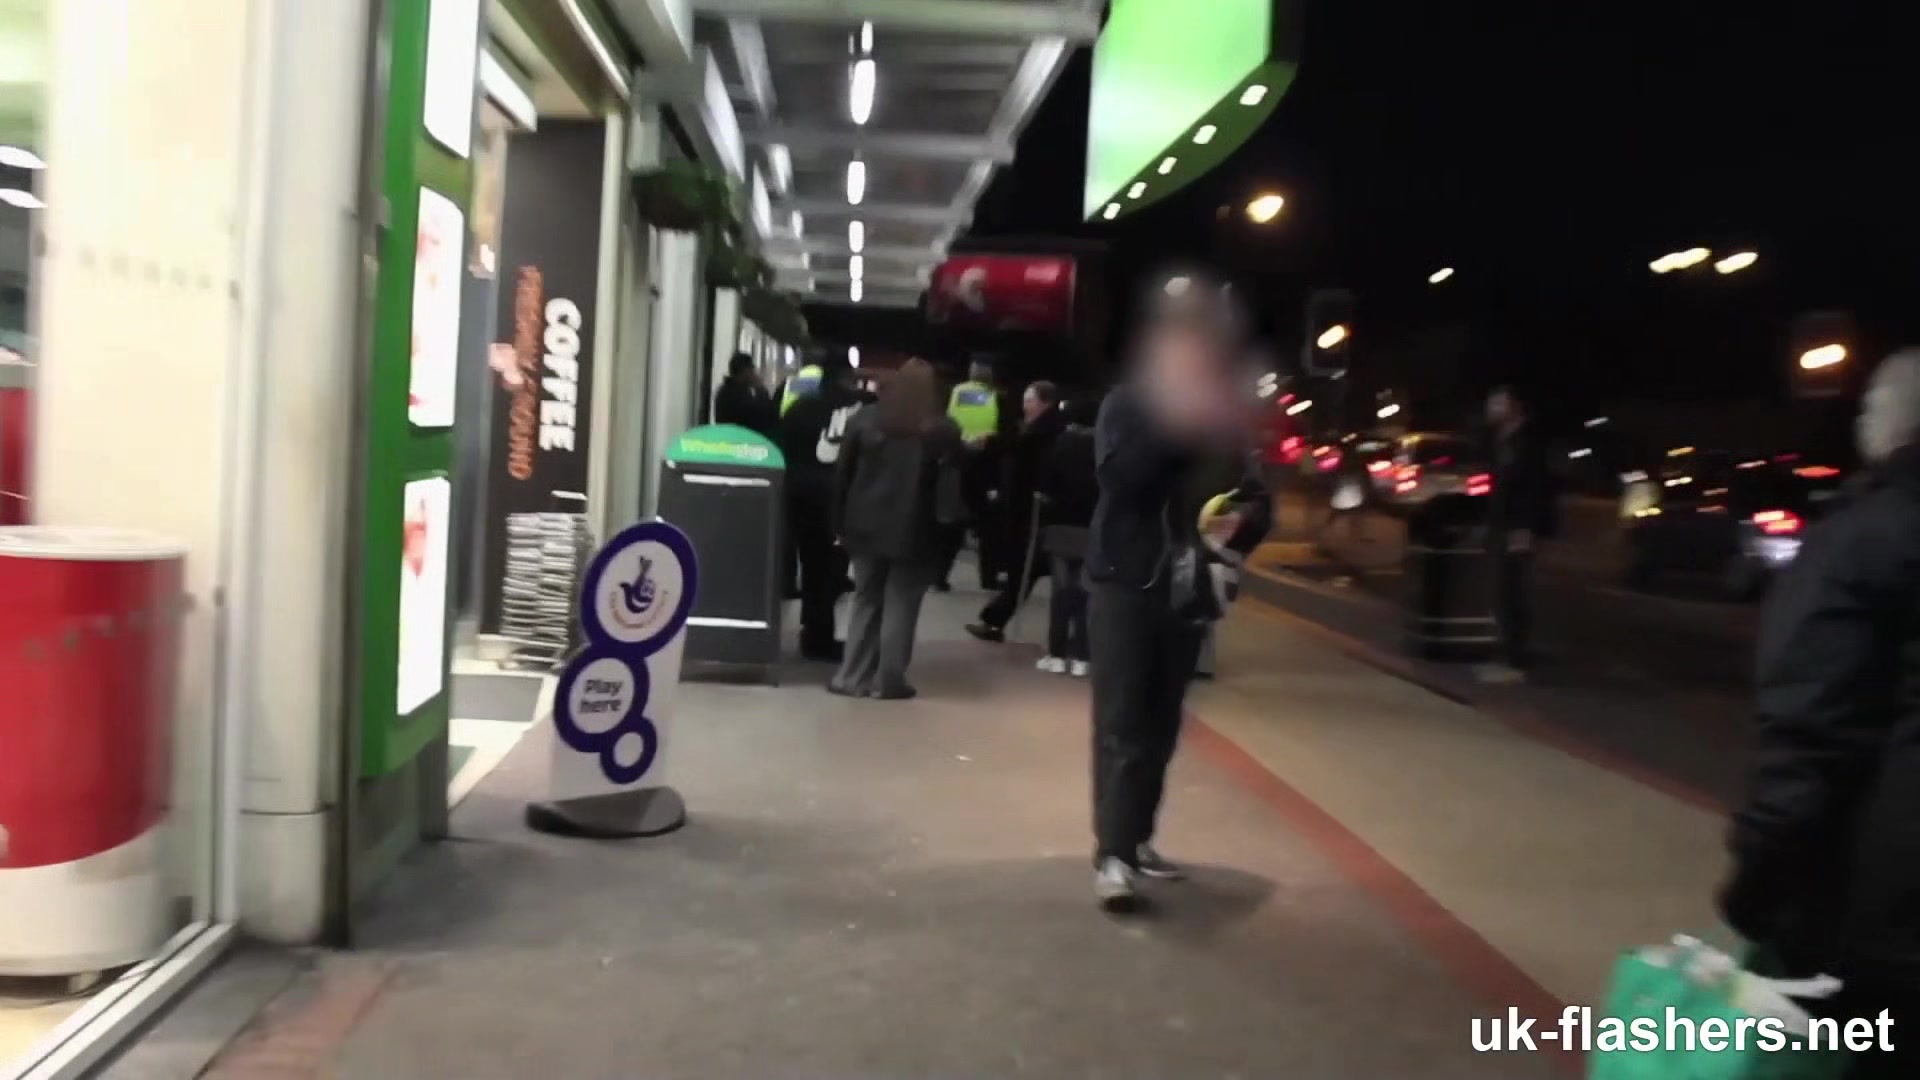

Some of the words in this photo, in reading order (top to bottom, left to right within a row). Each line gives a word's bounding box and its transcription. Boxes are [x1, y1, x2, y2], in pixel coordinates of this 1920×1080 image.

[538, 298, 582, 451] COFFEE
[584, 678, 624, 697] Play
[579, 699, 622, 714] here
